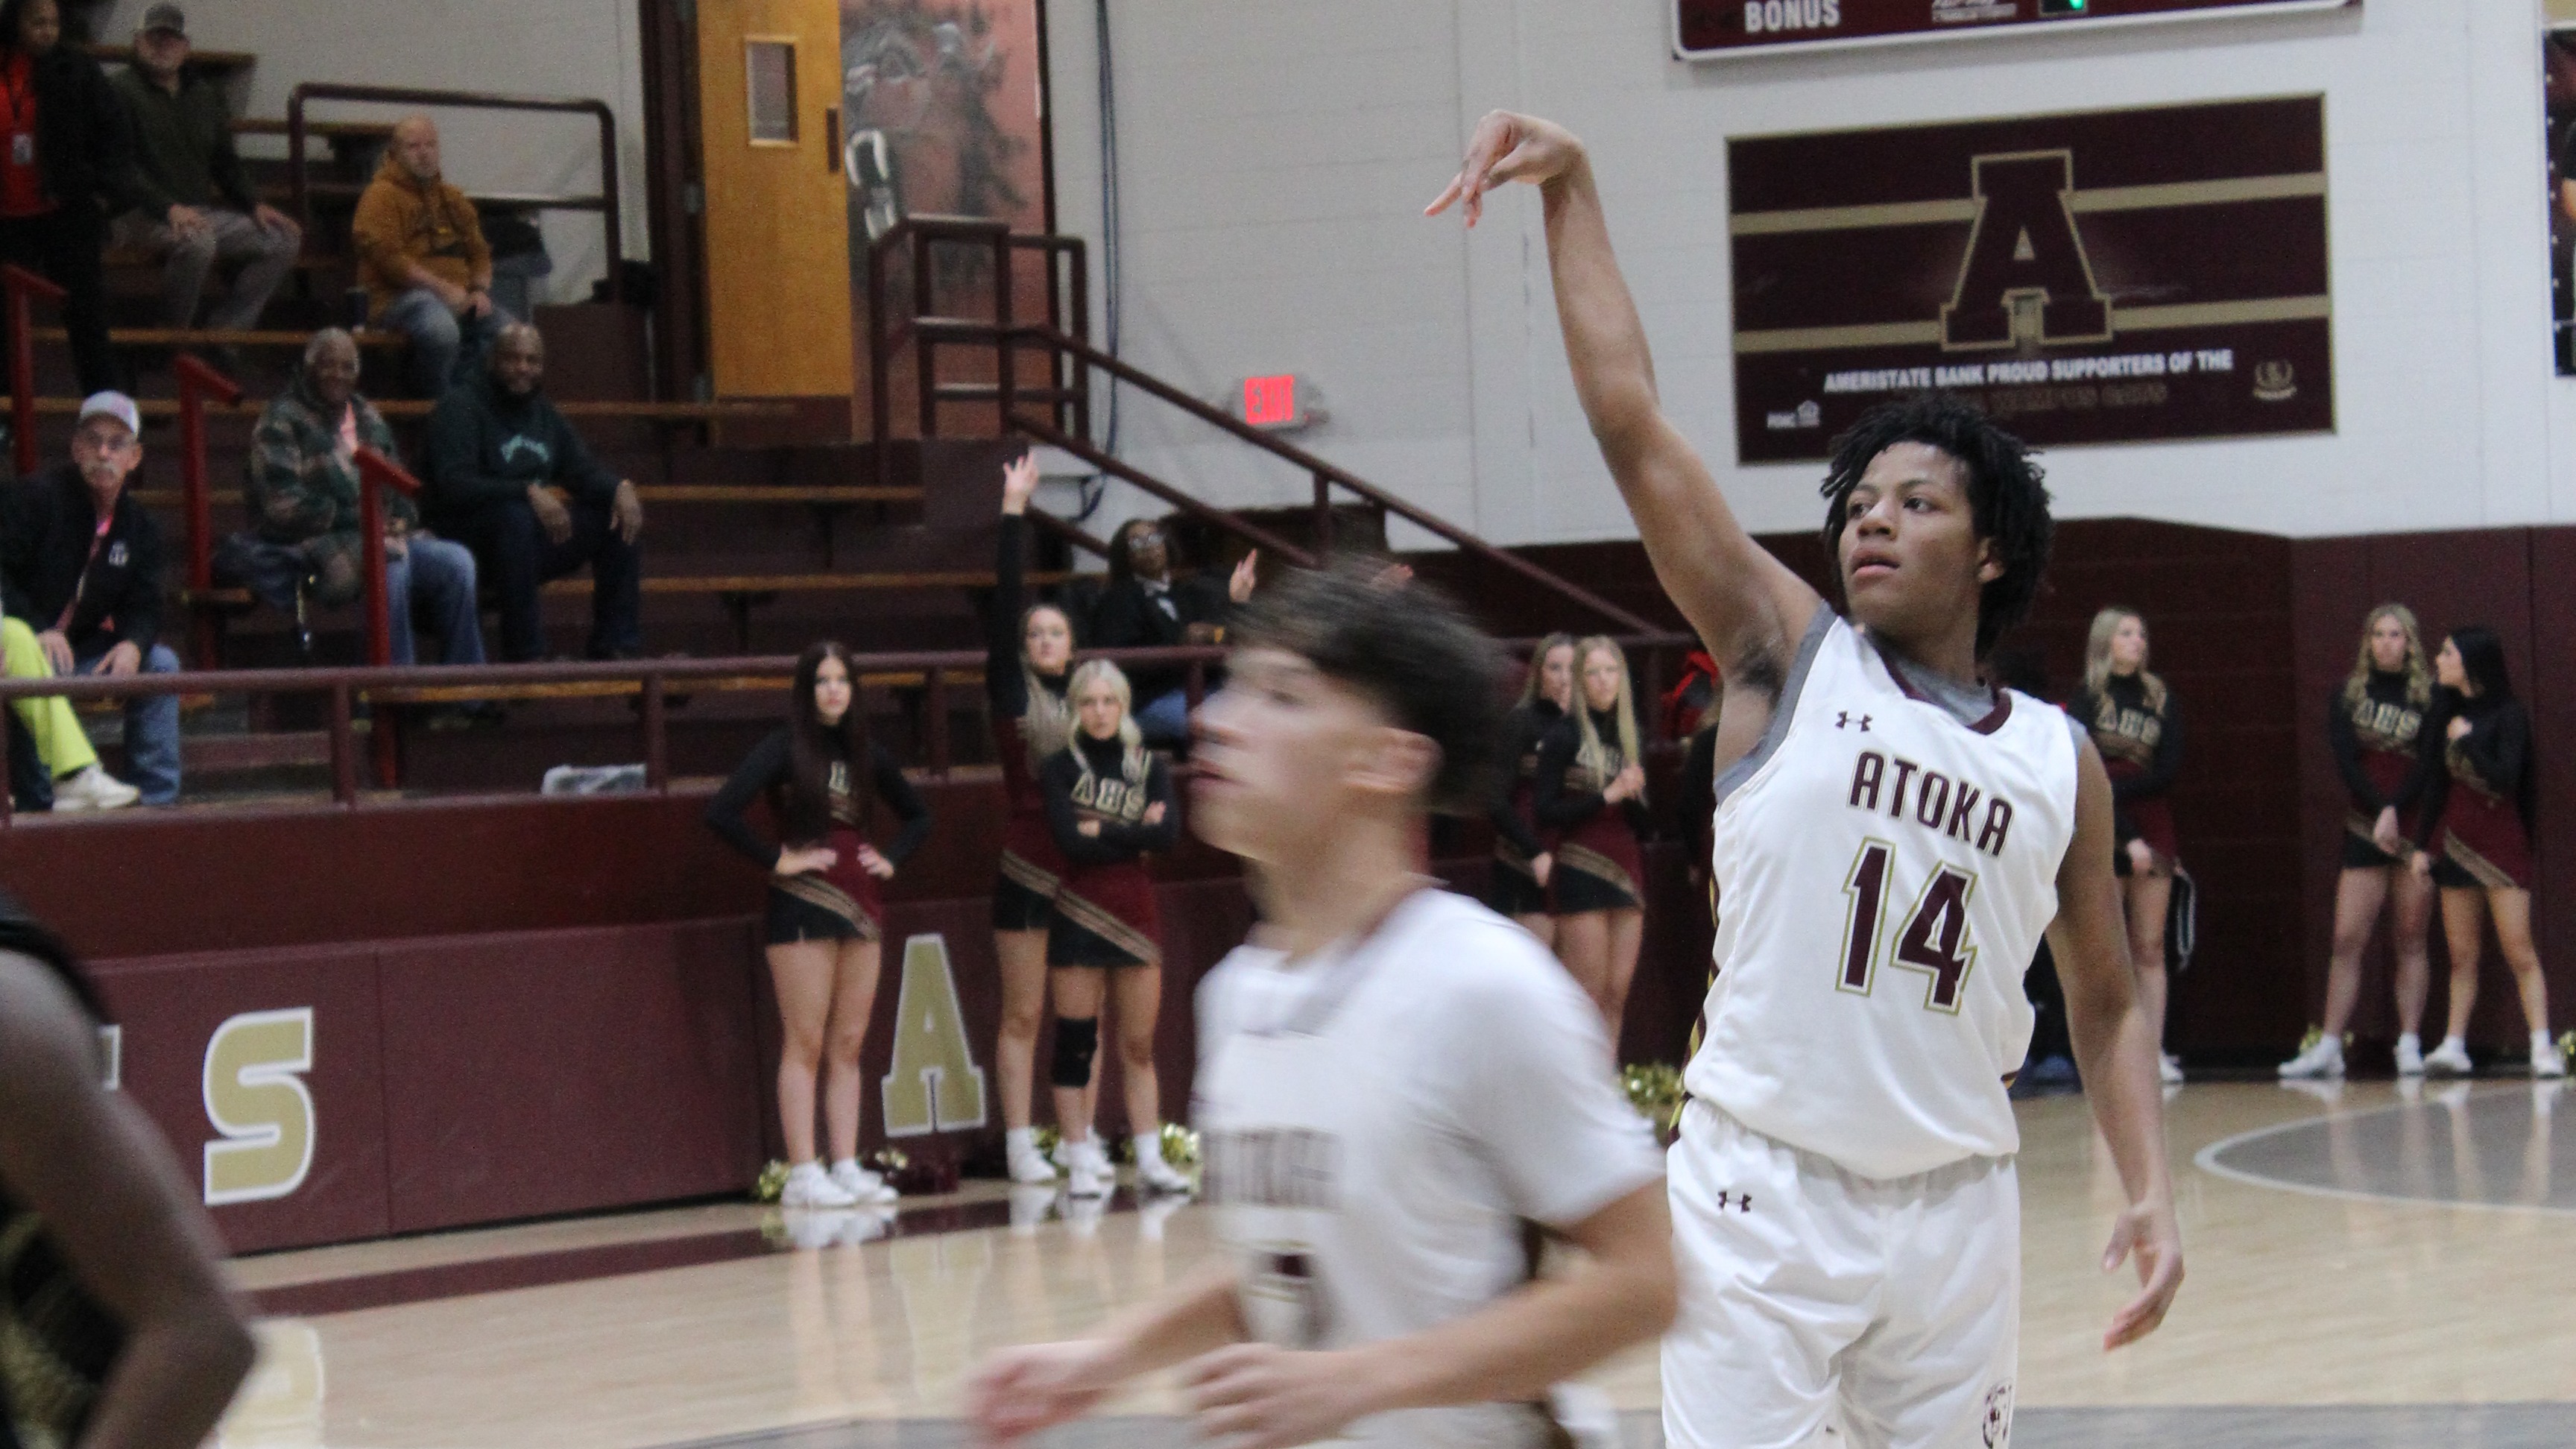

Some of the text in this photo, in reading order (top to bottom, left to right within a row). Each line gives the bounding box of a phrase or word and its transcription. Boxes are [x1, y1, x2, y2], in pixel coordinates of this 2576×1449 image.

[1744, 0, 1840, 33] BONUS
[1939, 148, 2113, 352] A
[1824, 348, 2234, 394] AMERISTATE BANK PROUD SUPPORTERS OF THE
[1846, 749, 2013, 858] ATOKA
[1835, 836, 1979, 1016] 14
[881, 932, 986, 1137] A
